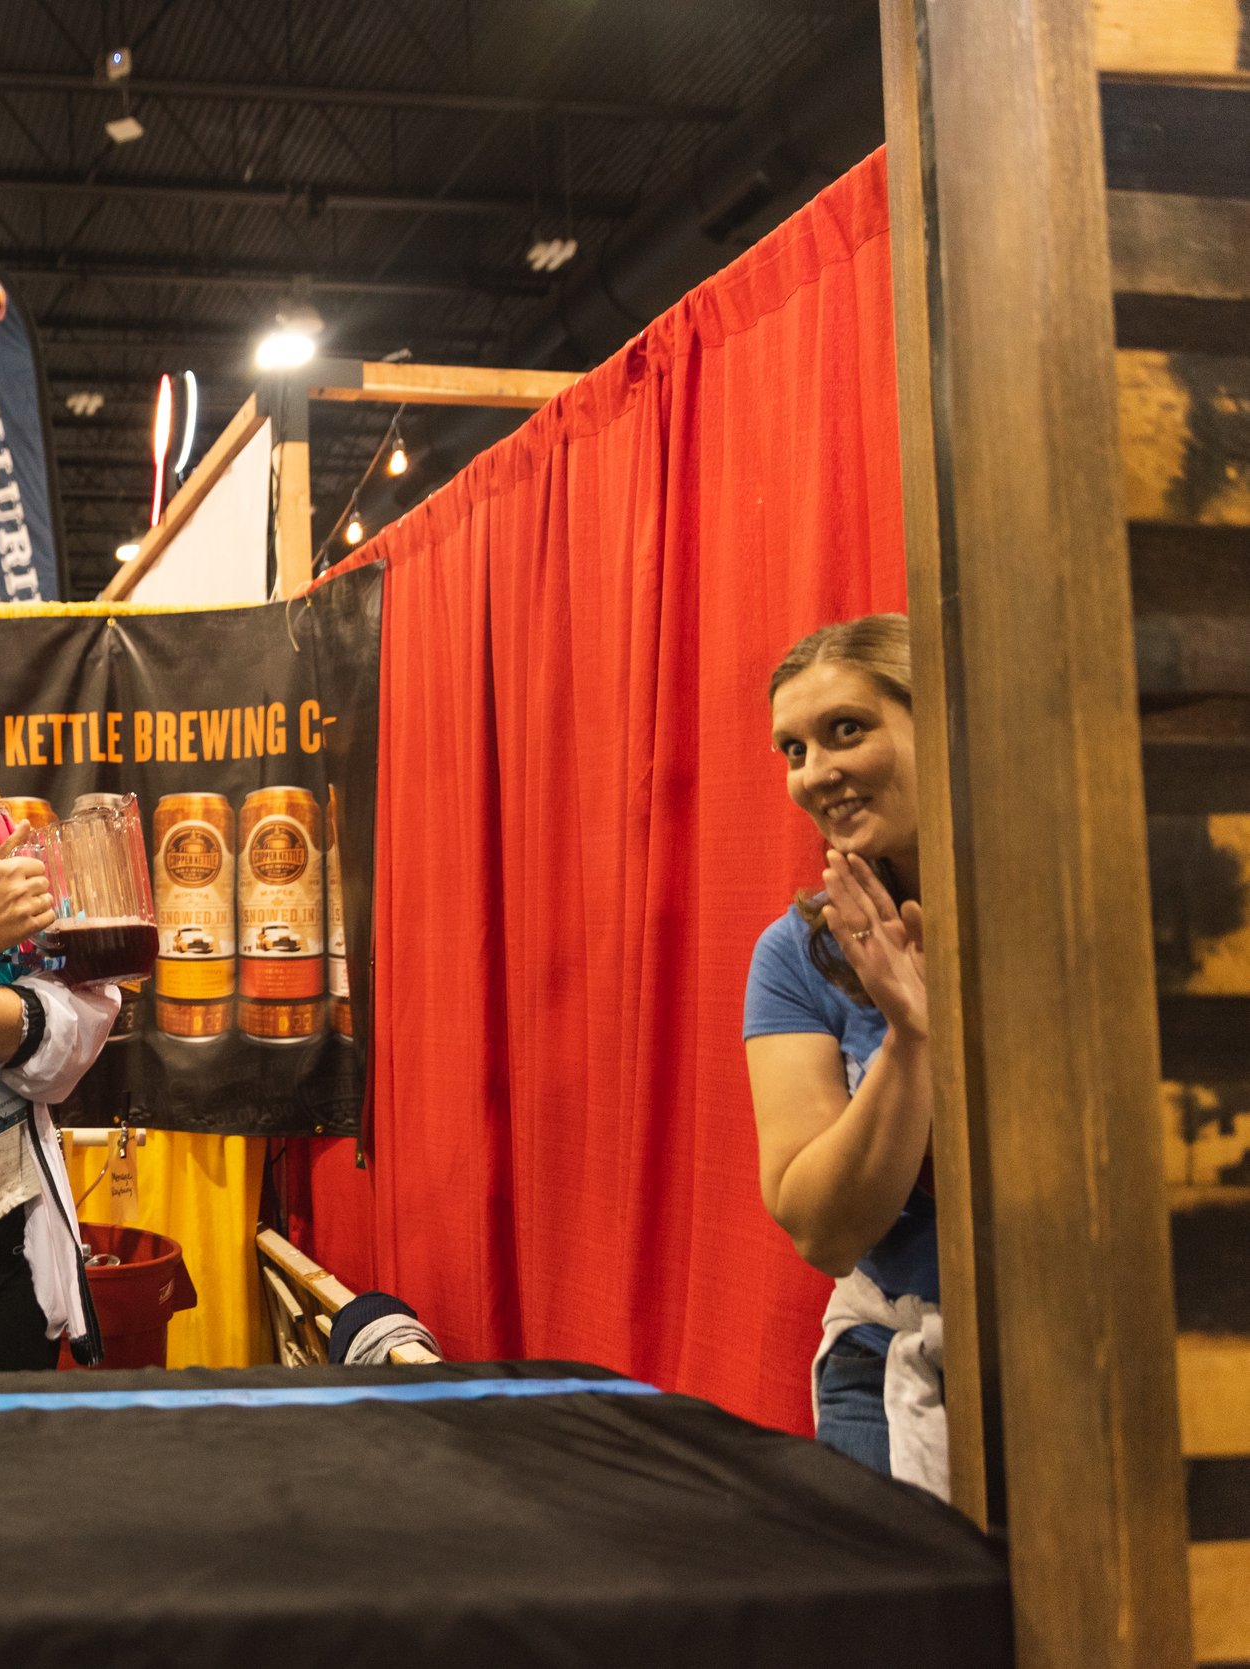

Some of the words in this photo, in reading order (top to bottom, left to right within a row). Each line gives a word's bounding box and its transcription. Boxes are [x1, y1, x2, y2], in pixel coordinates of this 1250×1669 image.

[4, 710, 124, 768] KETTLE
[134, 701, 288, 763] BREWING
[253, 850, 278, 865] COPPER
[278, 849, 303, 862] KETTLE
[159, 910, 211, 925] SNOWED
[216, 910, 228, 925] IN
[243, 907, 298, 923] SNOWED
[302, 907, 315, 923] IN
